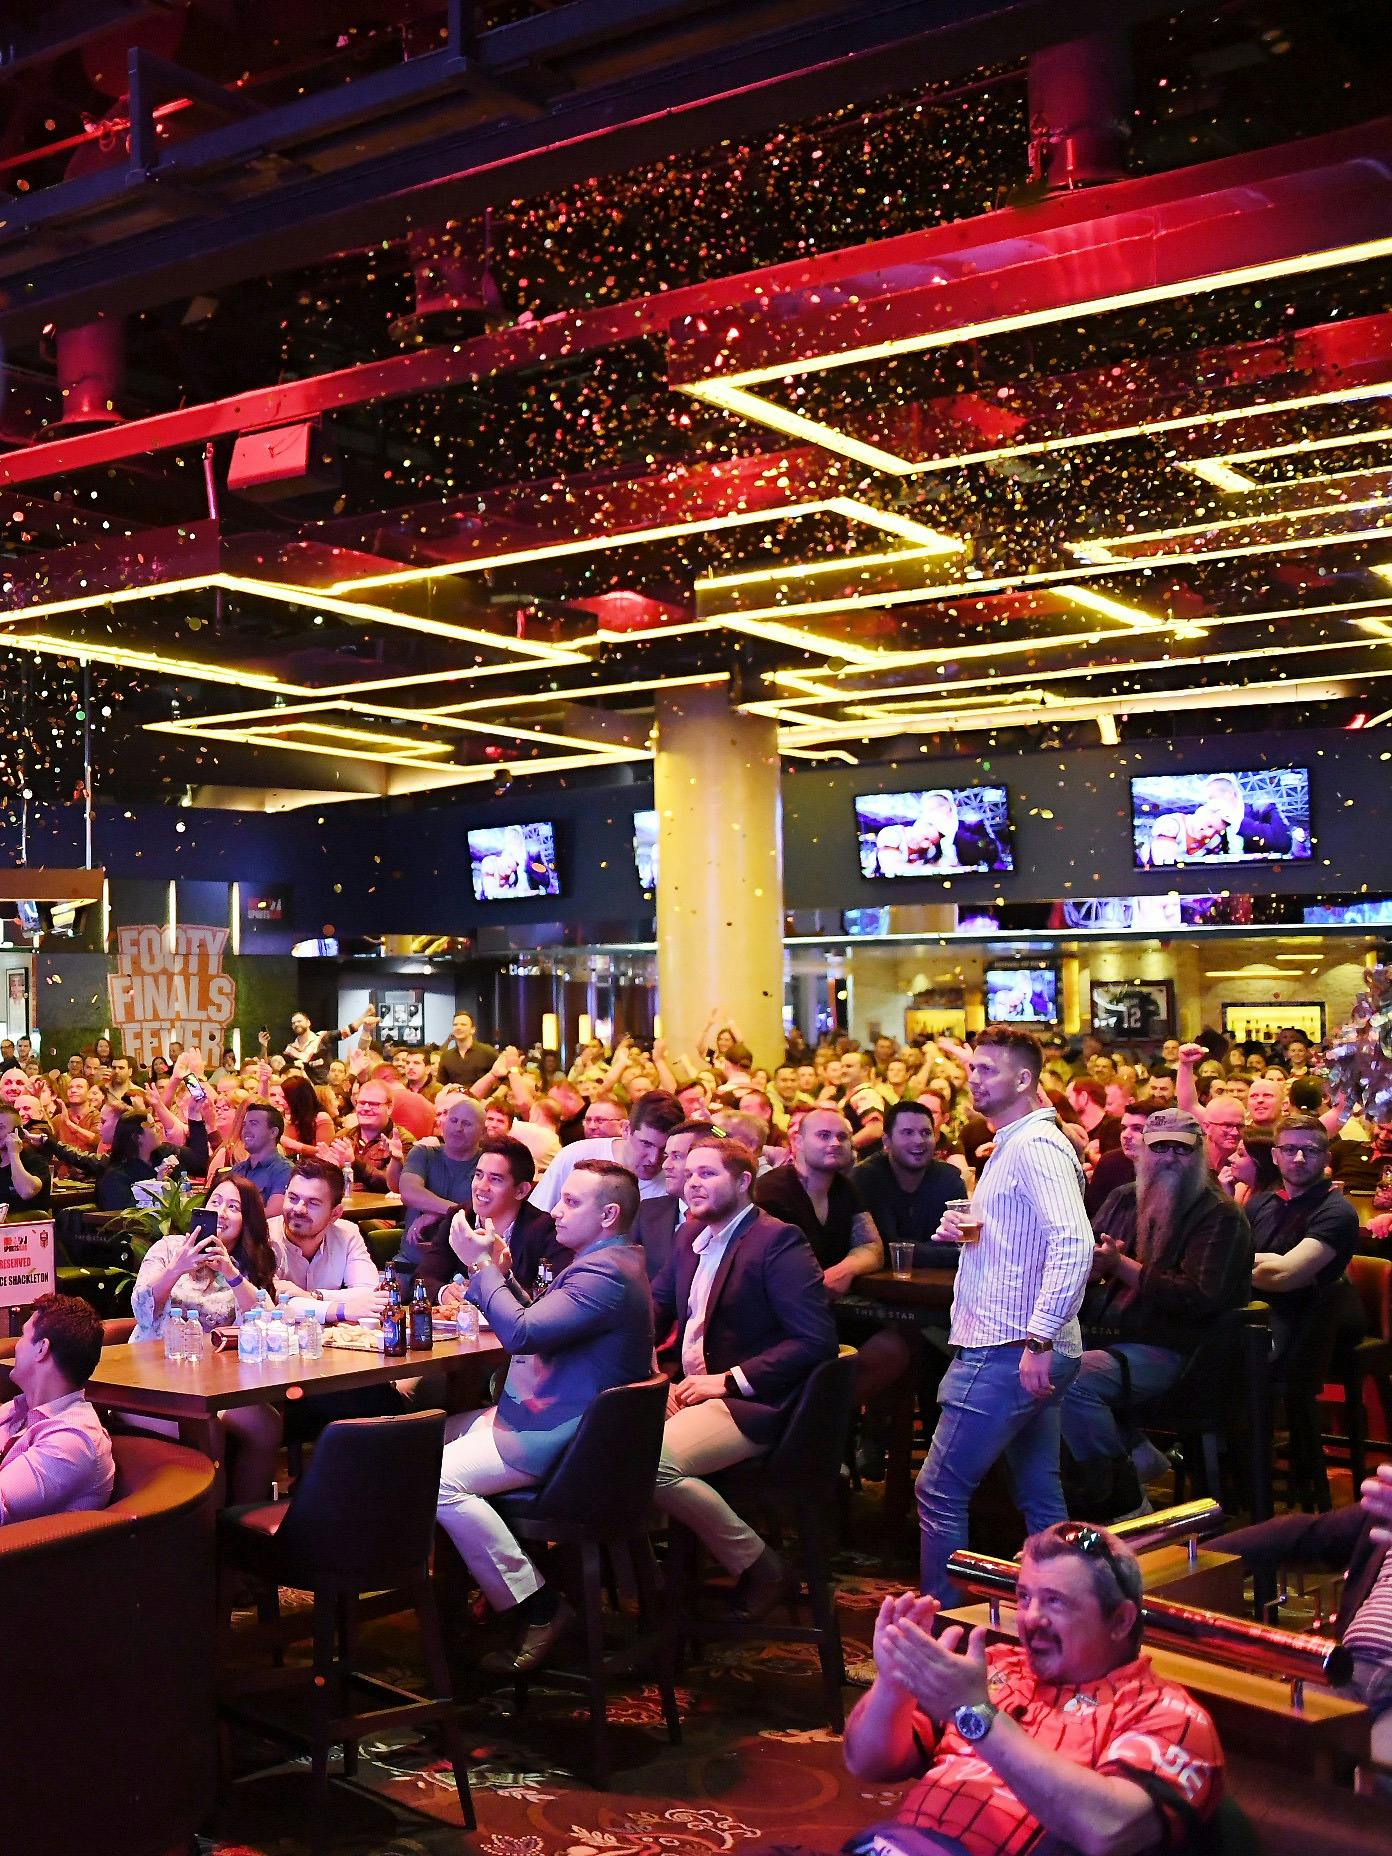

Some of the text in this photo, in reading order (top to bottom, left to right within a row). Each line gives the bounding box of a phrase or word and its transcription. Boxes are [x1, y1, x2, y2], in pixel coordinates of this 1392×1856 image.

[121, 926, 225, 976] FOOTY
[113, 974, 232, 1022] FINALS
[0, 1257, 31, 1269] RESERVED
[9, 1272, 49, 1285] SHACKLETON
